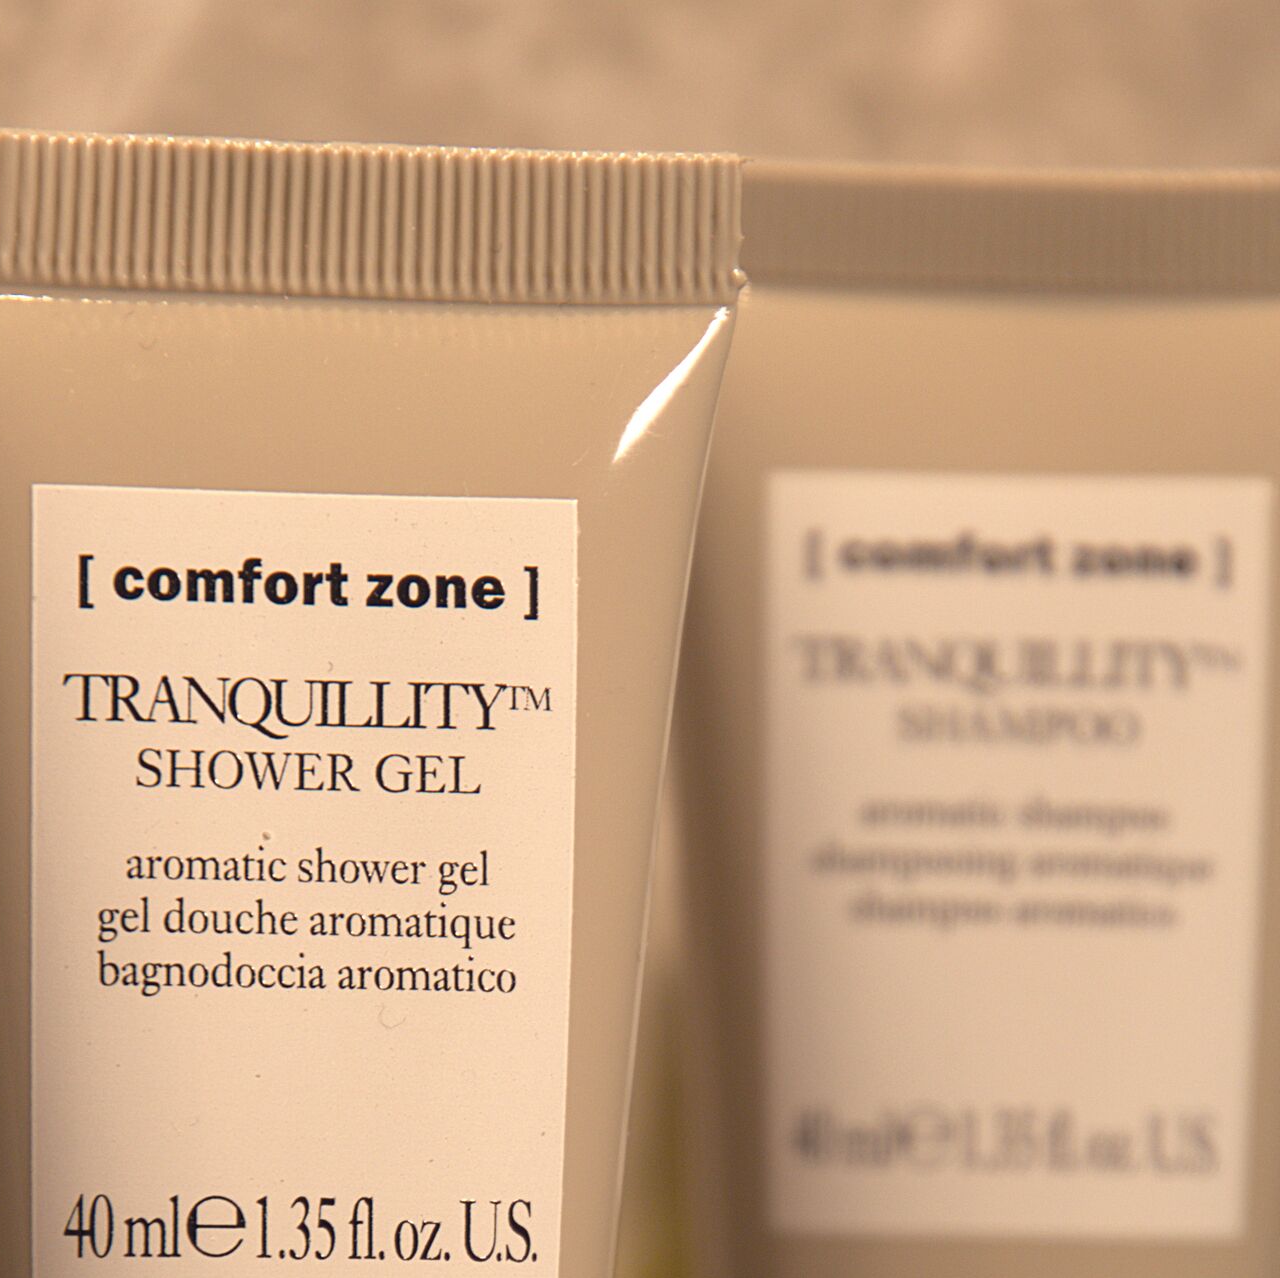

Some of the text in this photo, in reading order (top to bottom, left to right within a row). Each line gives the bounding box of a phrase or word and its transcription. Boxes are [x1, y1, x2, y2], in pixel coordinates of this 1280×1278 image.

[838, 530, 1056, 576] comfort
[1072, 540, 1200, 580] zone
[112, 558, 349, 606] comfort
[365, 574, 506, 610] zone
[135, 748, 482, 795] SHOWER GEL
[125, 847, 490, 896] aromatic shower gel
[97, 897, 517, 949] gel douche aromatique
[96, 950, 518, 997] bagnodoccia aromatico
[62, 1193, 115, 1260] 40
[122, 1194, 181, 1259] ml
[255, 1195, 337, 1261] 1.35
[347, 1195, 386, 1261] fl.
[393, 1214, 452, 1262] oz.
[458, 1198, 539, 1264] U.S.
